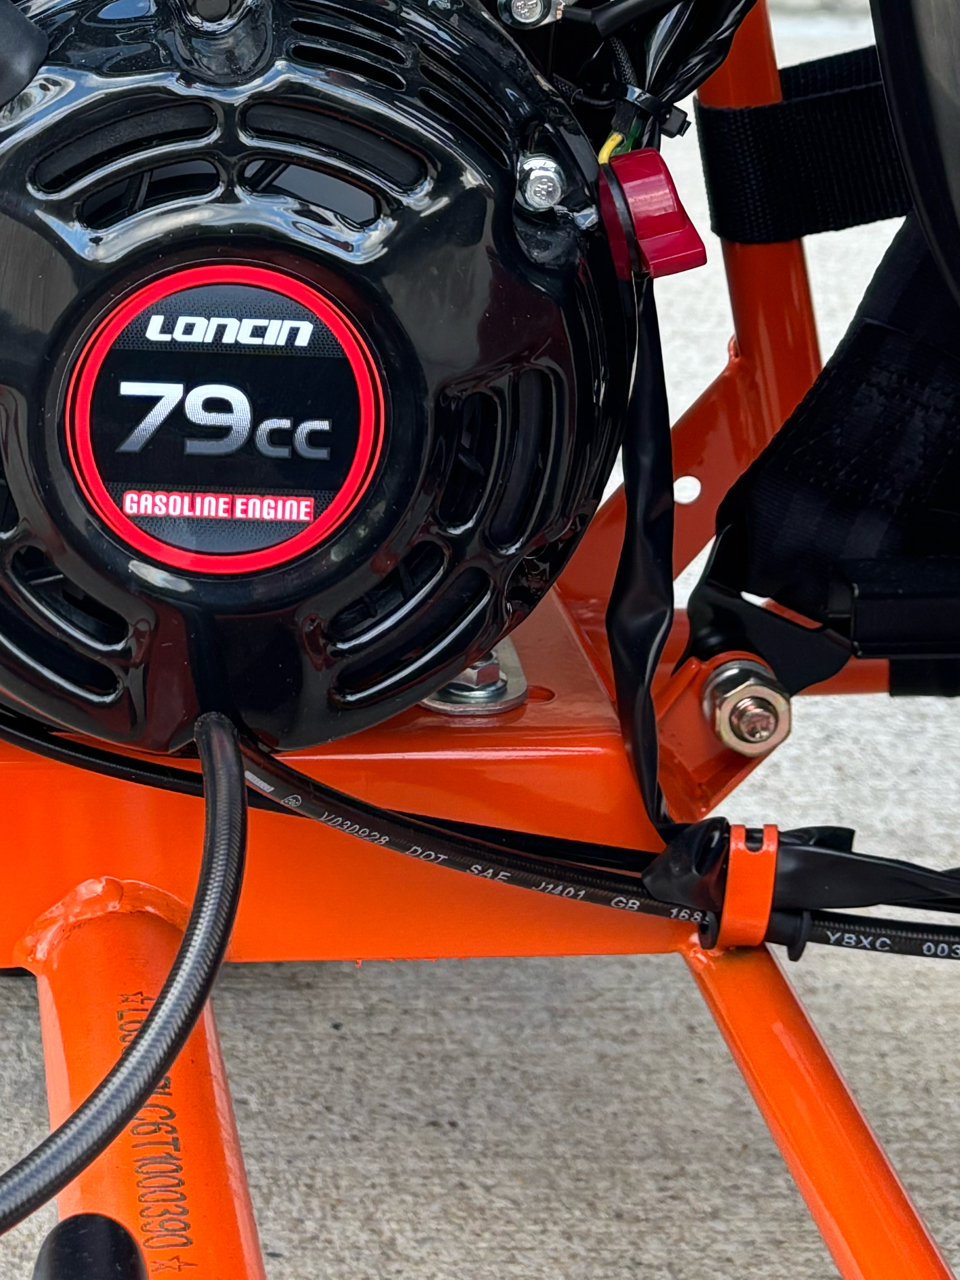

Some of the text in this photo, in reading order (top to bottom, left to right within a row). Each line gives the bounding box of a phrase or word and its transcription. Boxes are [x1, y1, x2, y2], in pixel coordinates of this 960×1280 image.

[124, 492, 313, 522] GASOLINE ENGINE
[404, 845, 448, 865] DOT
[466, 864, 512, 883] SAE
[610, 896, 641, 912] GB
[826, 930, 892, 951] YBXC
